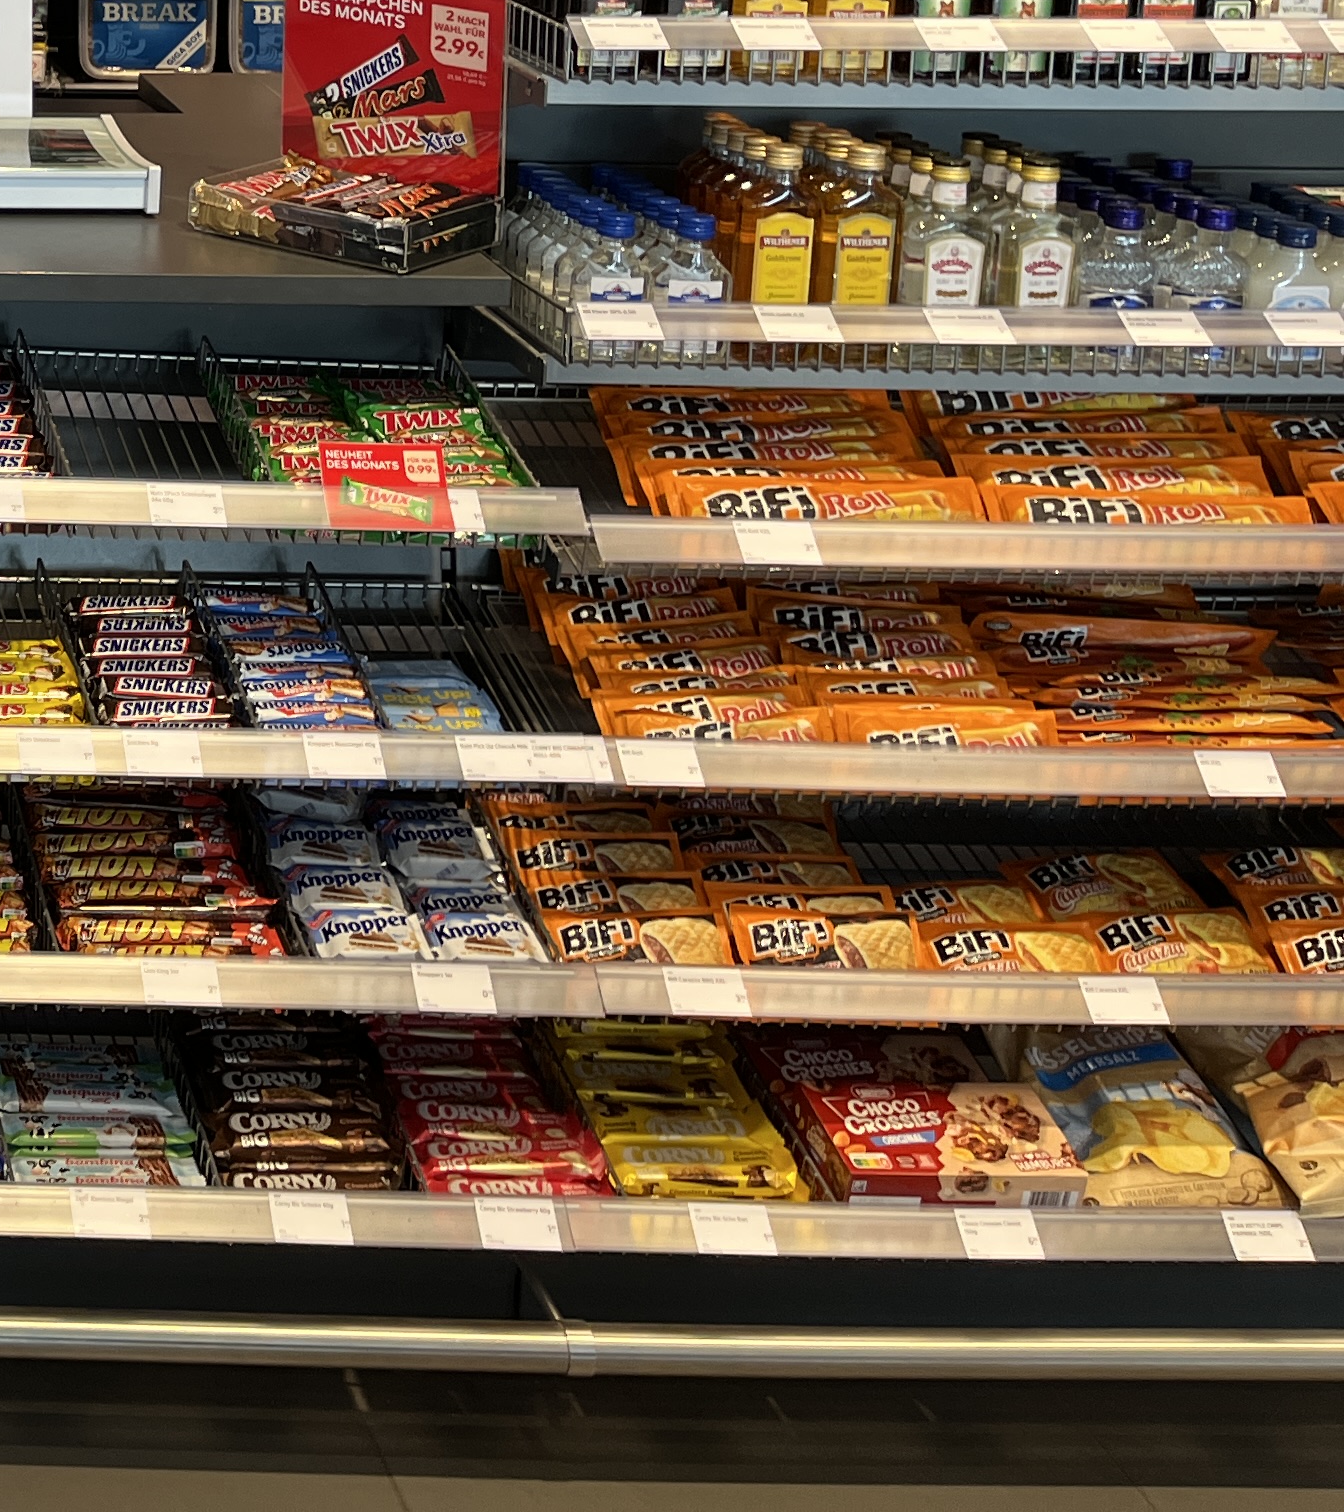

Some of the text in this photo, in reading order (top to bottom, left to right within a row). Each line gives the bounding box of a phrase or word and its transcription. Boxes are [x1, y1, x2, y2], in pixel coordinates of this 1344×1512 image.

[102, 3, 197, 23] BREAK
[335, 5, 406, 29] MONATS
[445, 10, 486, 27] 2 NACH
[434, 23, 486, 39] WAHL FÜR
[343, 44, 403, 95] SNICKERS
[325, 450, 373, 459] NEUHEIT
[326, 460, 399, 470] DES MONATS
[824, 491, 891, 516] Roll
[95, 919, 184, 941] LION
[1066, 1050, 1139, 1082] MEERSALZ
[847, 1098, 920, 1118] CHOCO
[844, 1111, 943, 1134] CROSSIES
[241, 1133, 269, 1147] BIG
[881, 1133, 925, 1144] ORIGINAL
